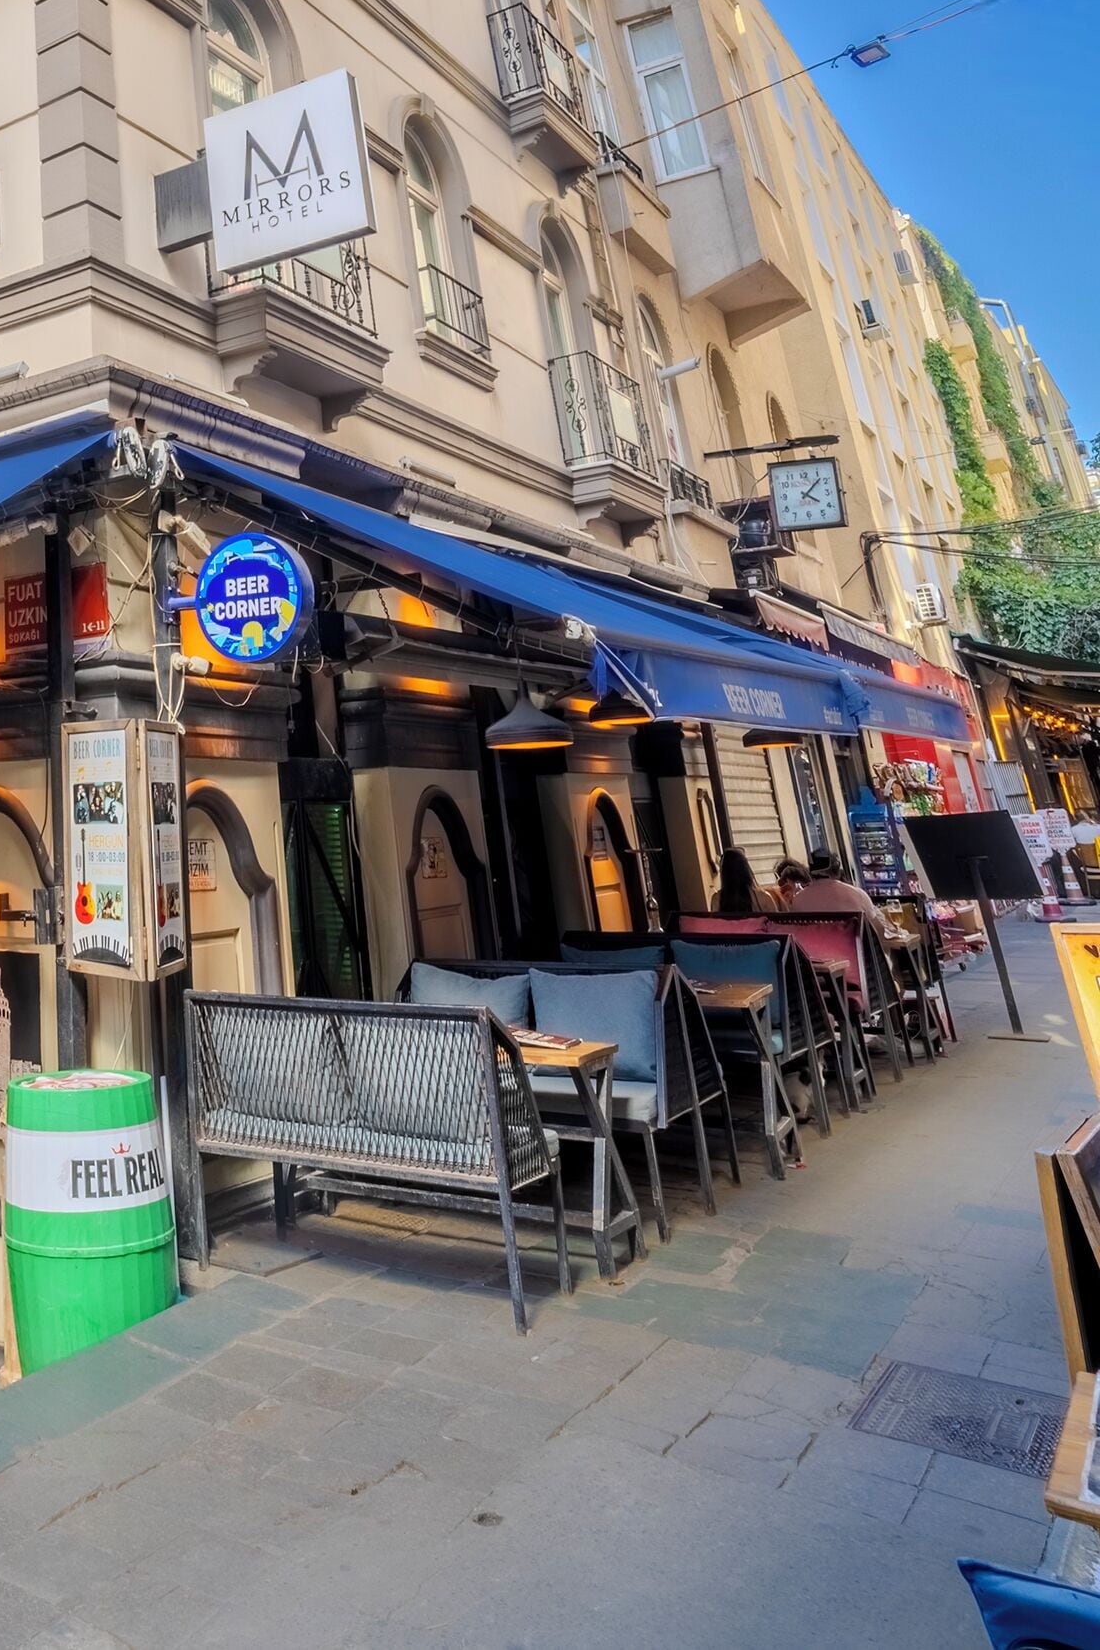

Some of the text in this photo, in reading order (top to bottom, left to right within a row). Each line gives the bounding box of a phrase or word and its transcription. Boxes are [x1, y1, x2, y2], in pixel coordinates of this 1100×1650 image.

[222, 171, 351, 227] MIRRORS
[251, 202, 323, 234] HOTEL
[7, 581, 43, 603] FUAT
[225, 575, 269, 597] BEER
[8, 605, 47, 628] UZKIN
[214, 596, 282, 621] CORNER
[8, 629, 41, 644] SOKAĞI
[722, 683, 755, 715] BEER
[73, 737, 121, 759] BEER CORNER
[189, 841, 208, 856] EMT
[71, 1147, 165, 1199] FEEL REAL
